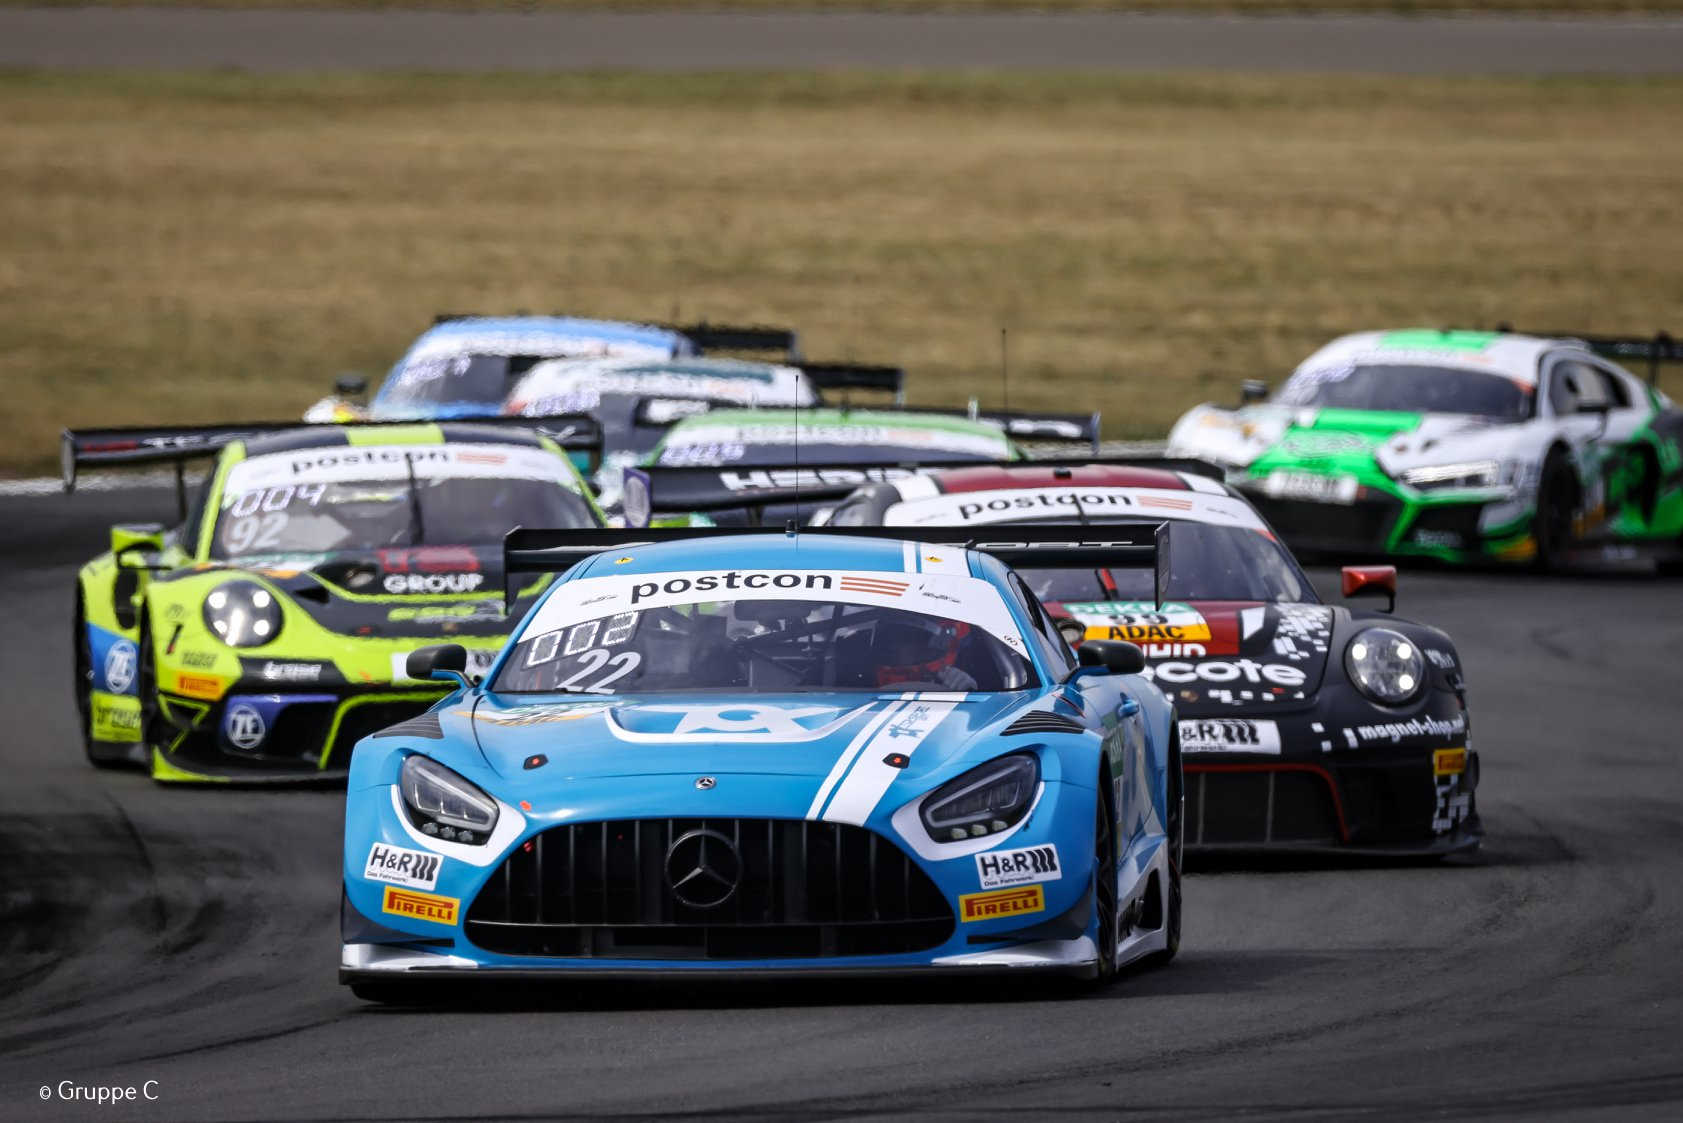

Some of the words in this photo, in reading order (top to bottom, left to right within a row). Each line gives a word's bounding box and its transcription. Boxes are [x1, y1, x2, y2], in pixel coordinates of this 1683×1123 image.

[958, 492, 1133, 520] postcon
[229, 511, 289, 553] 92
[383, 573, 484, 593] GROUP
[631, 571, 833, 604] postcon
[1108, 625, 1185, 640] ADAC
[555, 649, 641, 695] 22
[1143, 658, 1306, 687] cote
[370, 846, 413, 873] H&R
[980, 852, 1030, 876] H&R
[386, 890, 455, 921] PIRELLI
[964, 889, 1040, 918] PIRELLI
